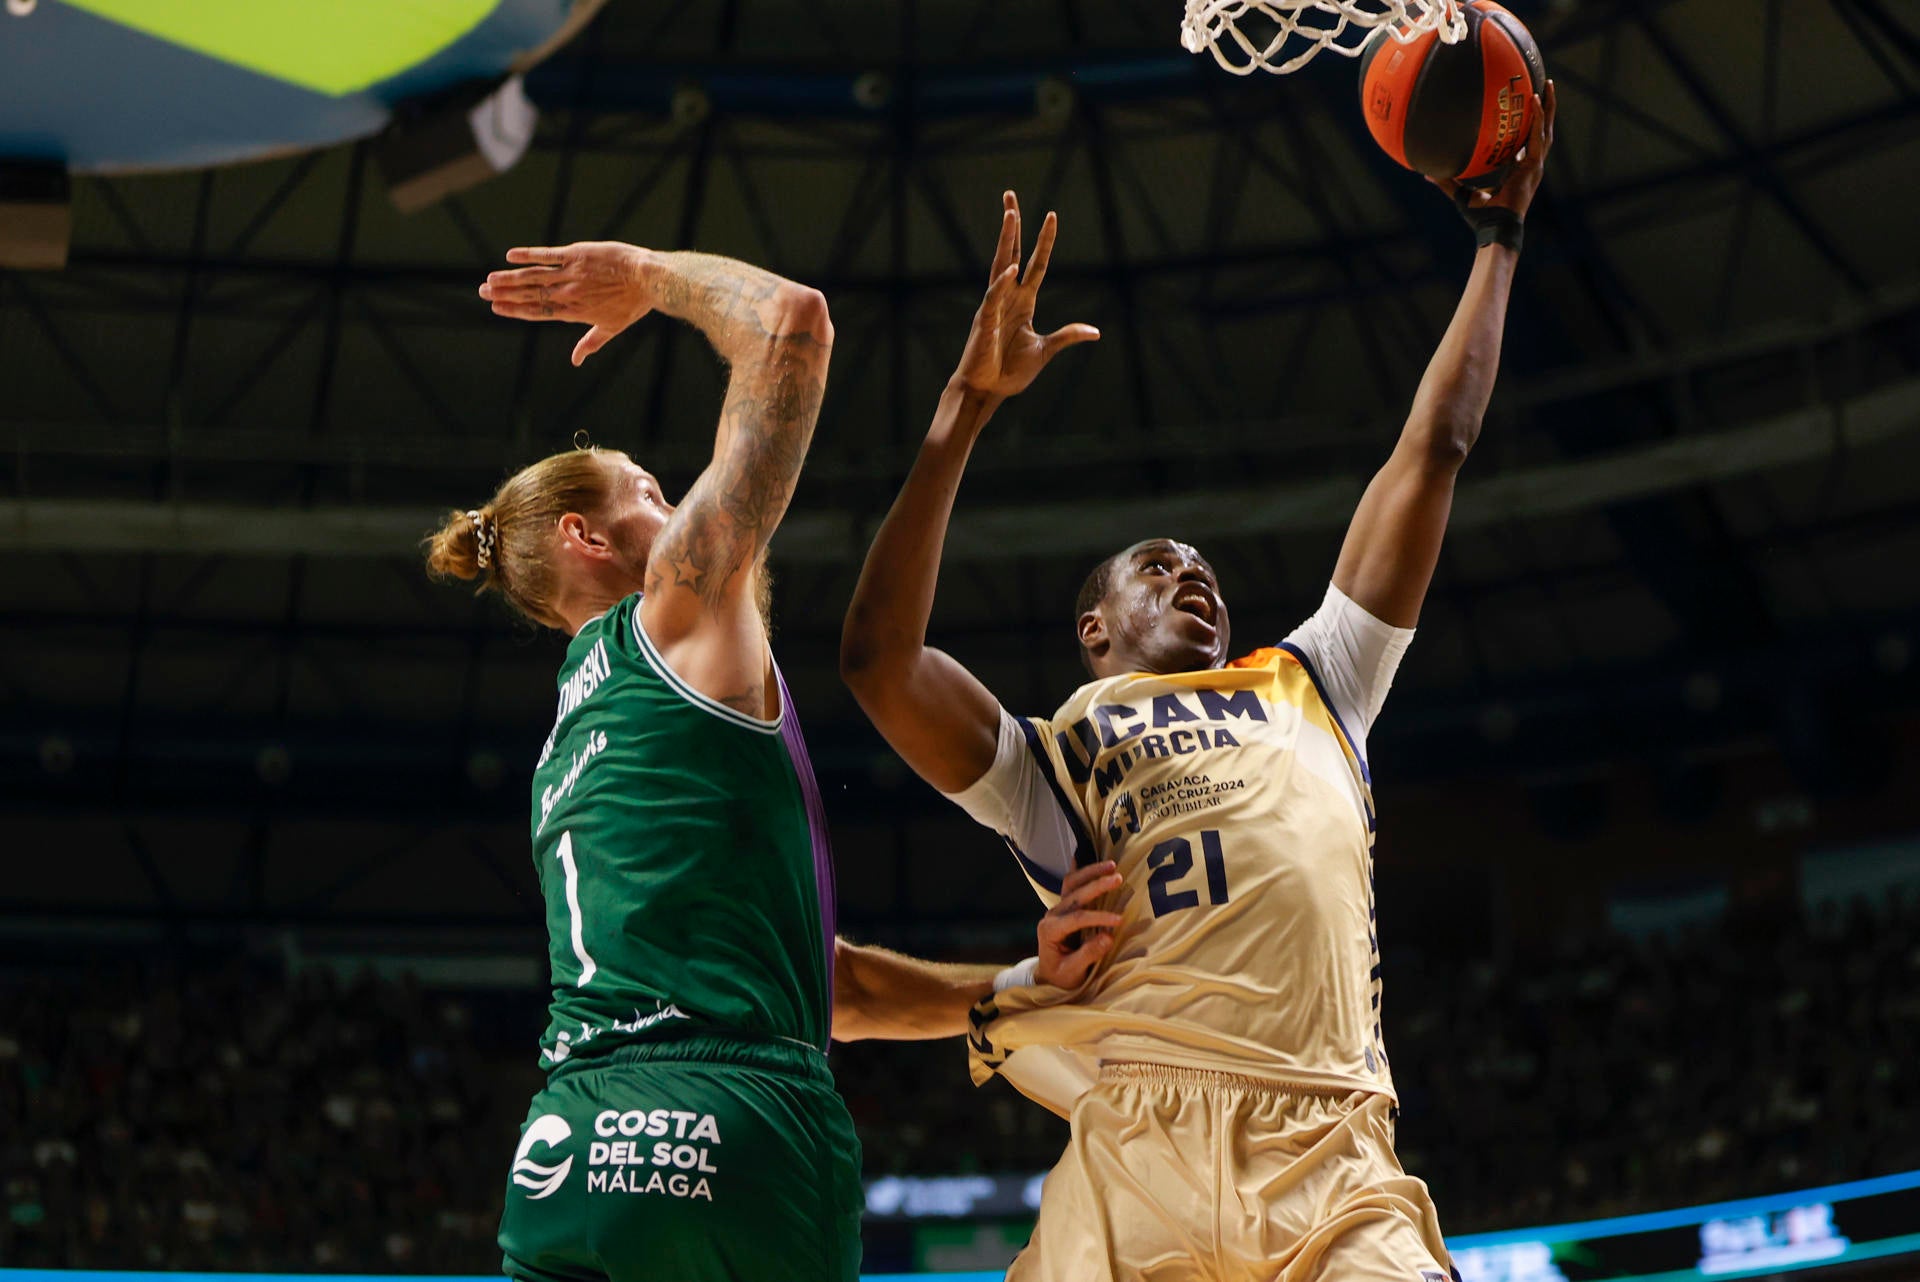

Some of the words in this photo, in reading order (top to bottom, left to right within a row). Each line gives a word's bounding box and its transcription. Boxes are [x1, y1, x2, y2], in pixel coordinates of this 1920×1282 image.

[1056, 689, 1269, 785] UCAM
[1094, 727, 1241, 799] MURCIA
[1140, 775, 1211, 799] CARAVACA
[1161, 794, 1175, 805] LA
[1177, 786, 1211, 800] CRUZ
[1213, 779, 1245, 793] 2024
[1172, 796, 1221, 816] JUBILAR
[1147, 829, 1229, 919] 21
[556, 829, 597, 988] 1
[594, 1109, 721, 1144] COSTA
[588, 1141, 645, 1166] DEL
[651, 1141, 717, 1174] SOL
[587, 1165, 713, 1201] MÁLAGA
